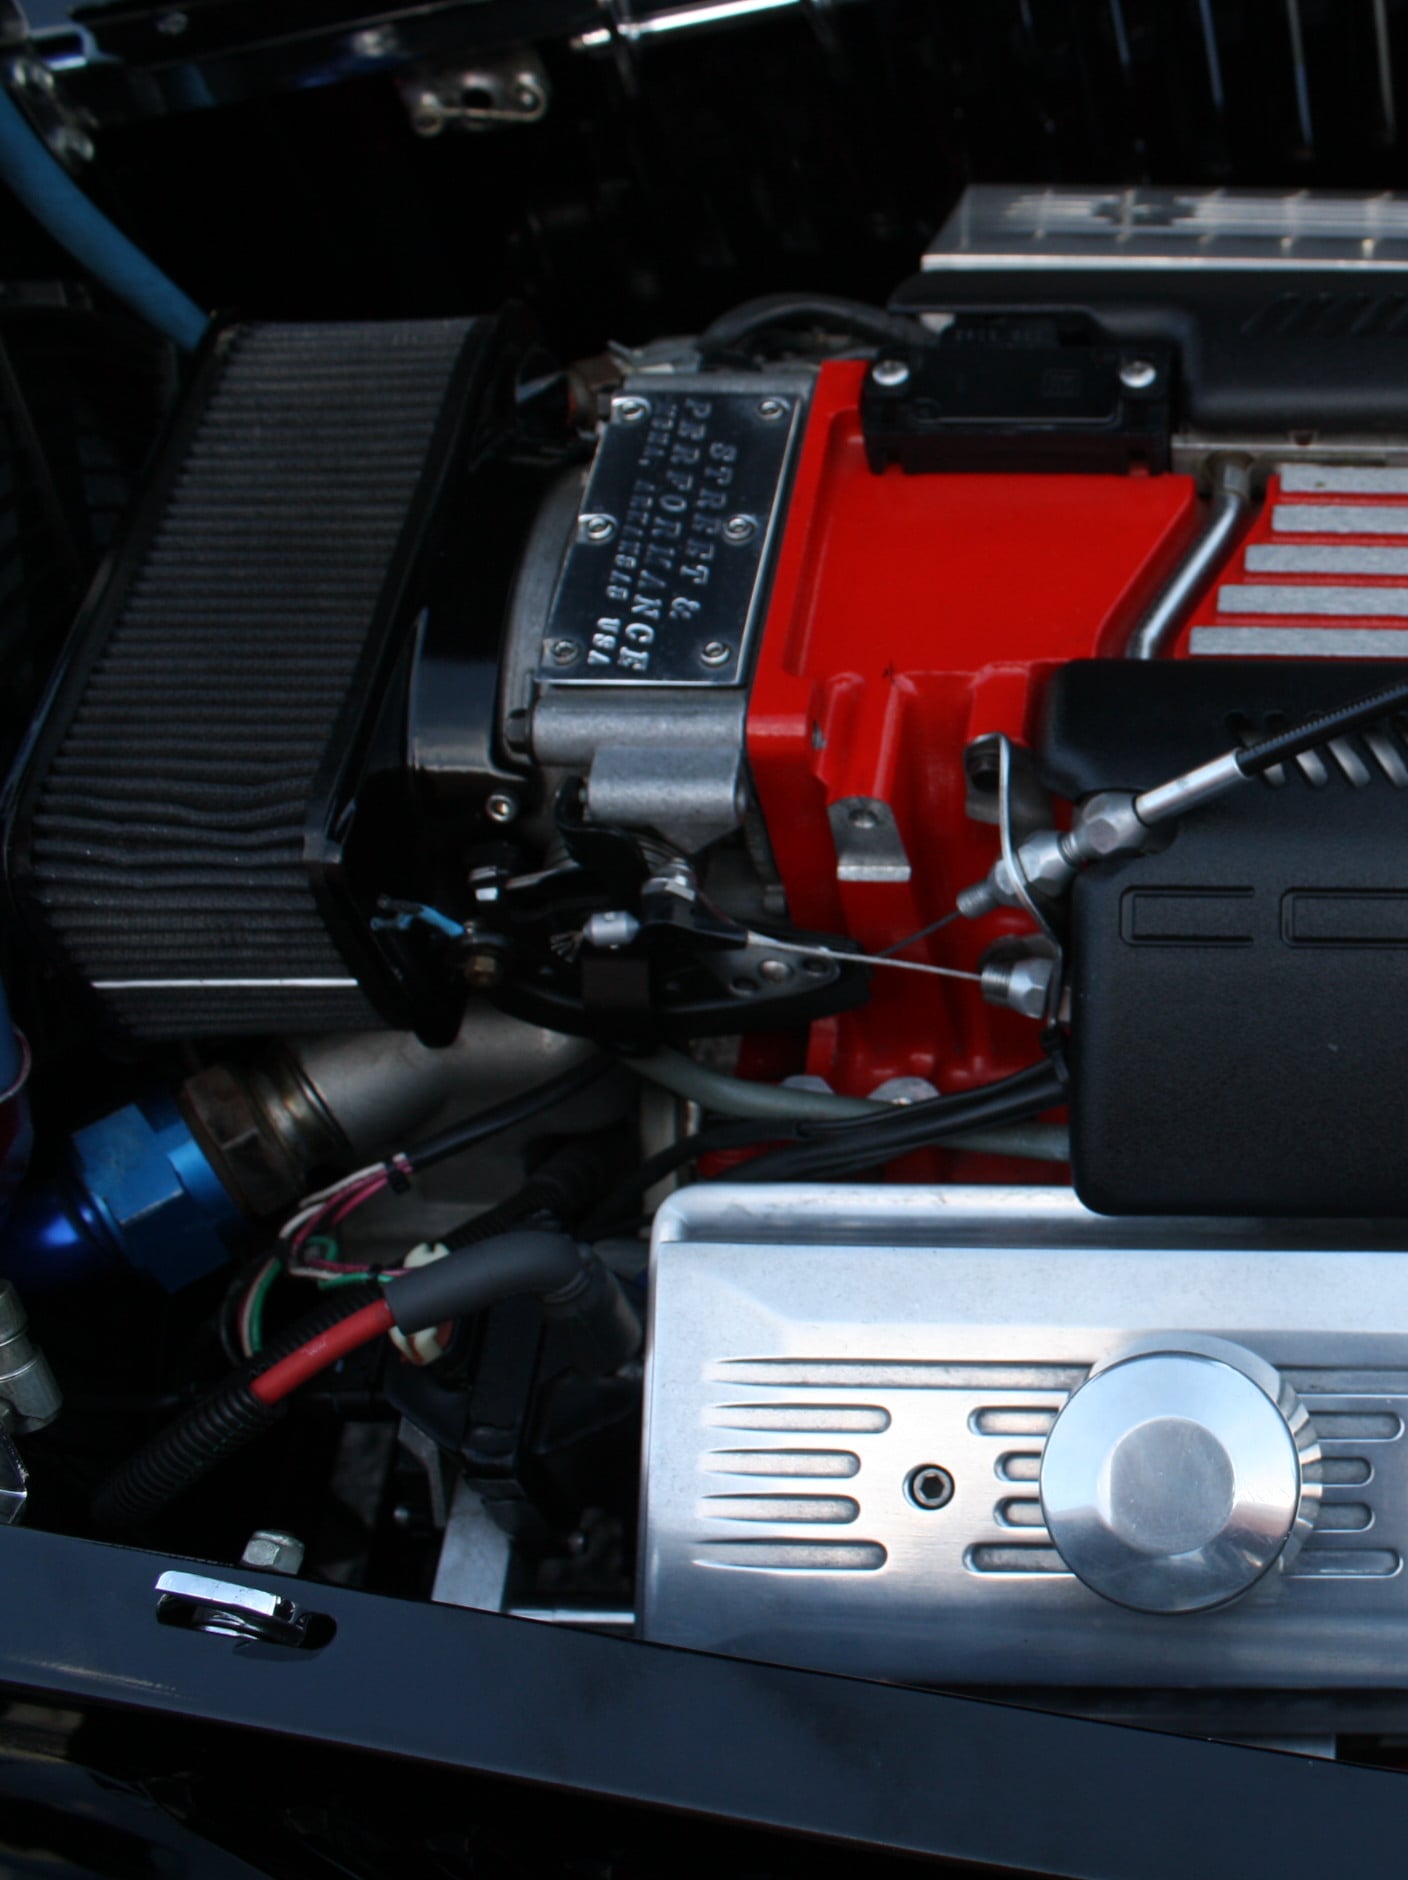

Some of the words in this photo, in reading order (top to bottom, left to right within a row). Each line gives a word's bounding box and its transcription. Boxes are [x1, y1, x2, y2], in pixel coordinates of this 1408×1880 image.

[616, 398, 712, 673] PERFORMANCE
[680, 440, 738, 587] STREET
[587, 615, 622, 667] USA
[669, 596, 701, 620] &
